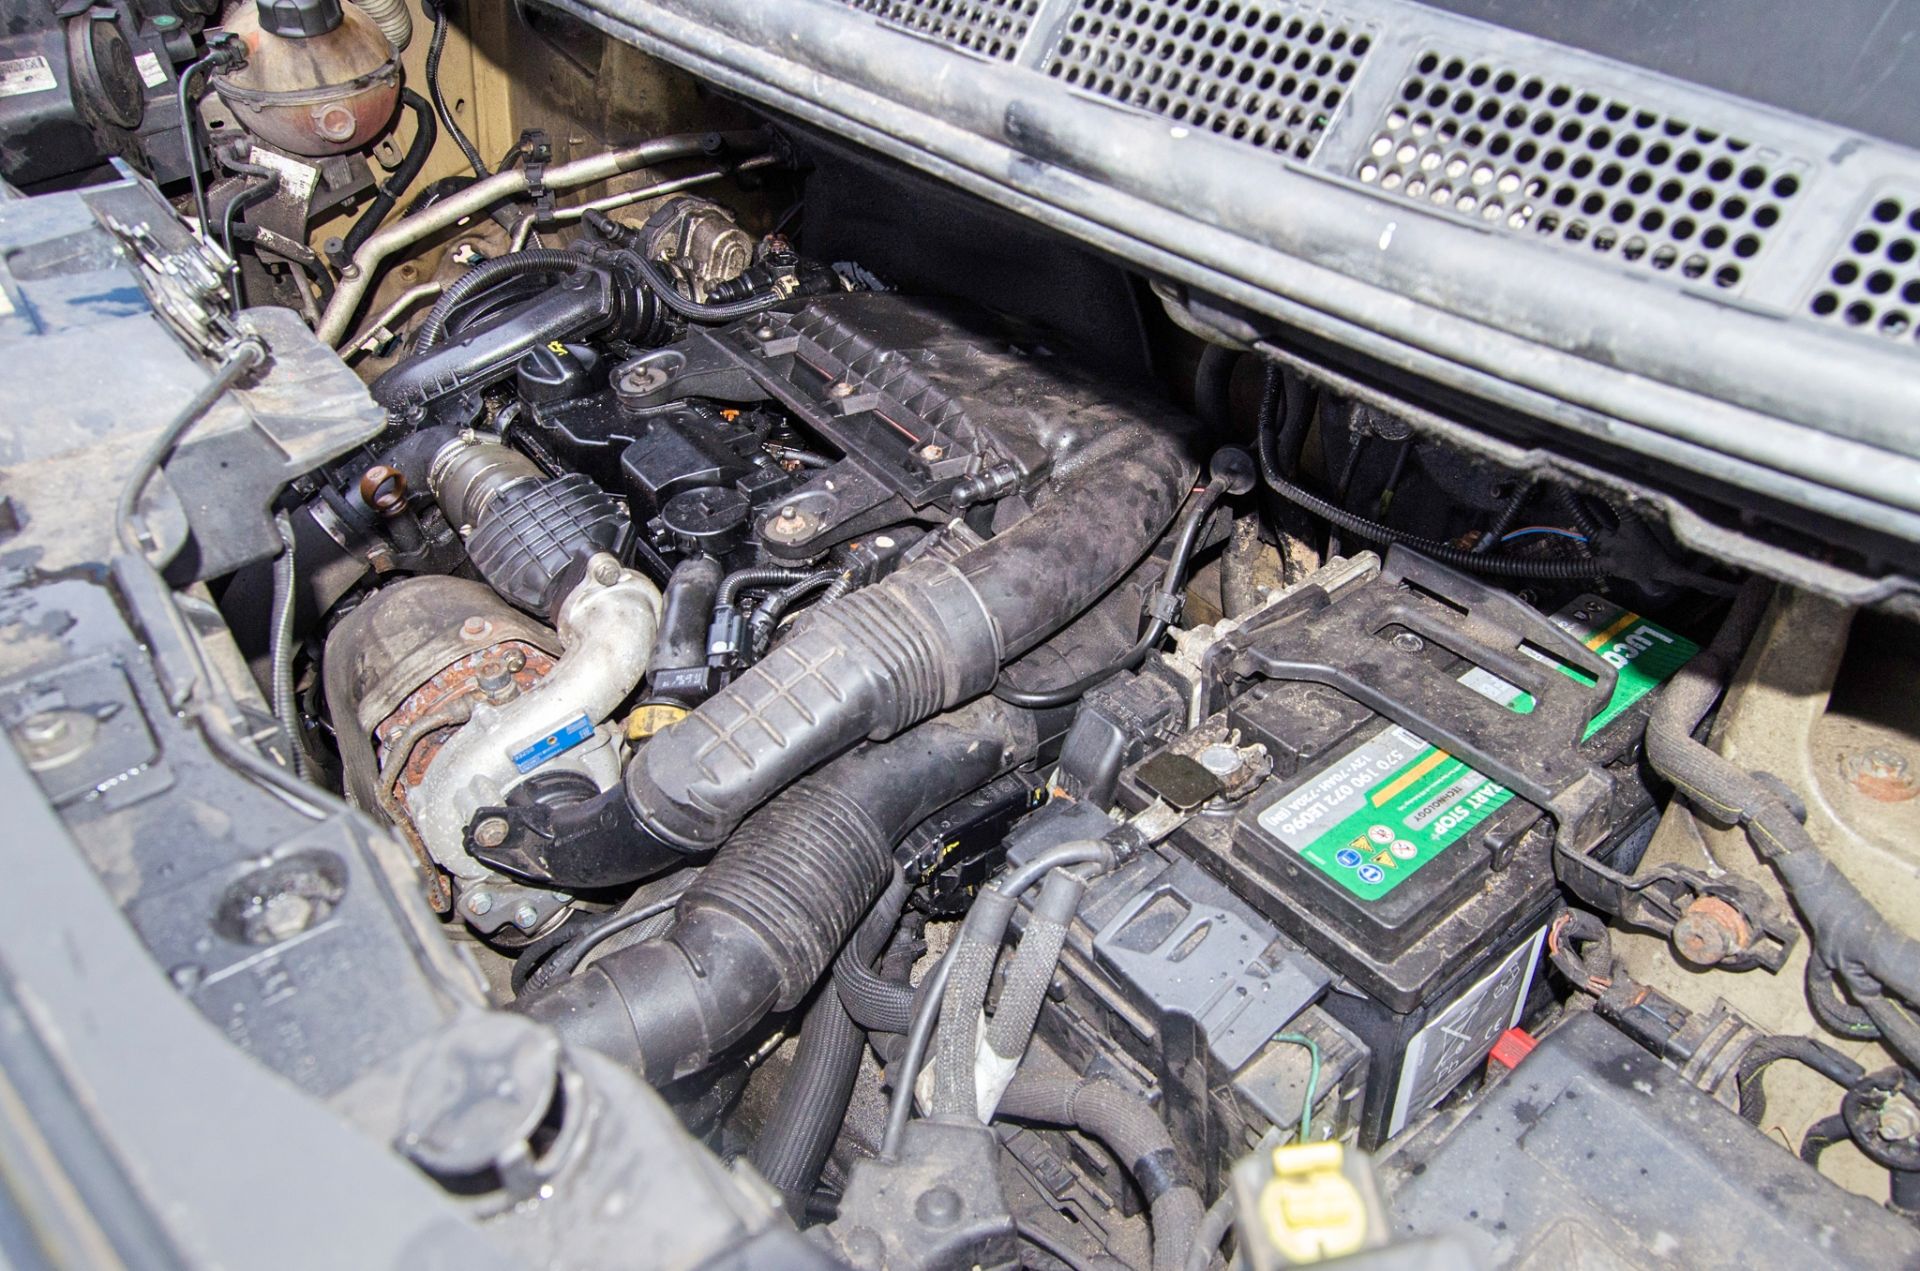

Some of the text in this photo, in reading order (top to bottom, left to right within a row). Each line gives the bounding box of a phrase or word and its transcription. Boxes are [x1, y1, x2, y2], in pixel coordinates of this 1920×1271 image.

[1375, 749, 1404, 771] 570
[1350, 767, 1379, 788] 190
[1323, 784, 1354, 806] 072
[1413, 785, 1463, 822] TECHNOLOGY
[1465, 782, 1505, 810] TART
[1281, 801, 1330, 835] LE096
